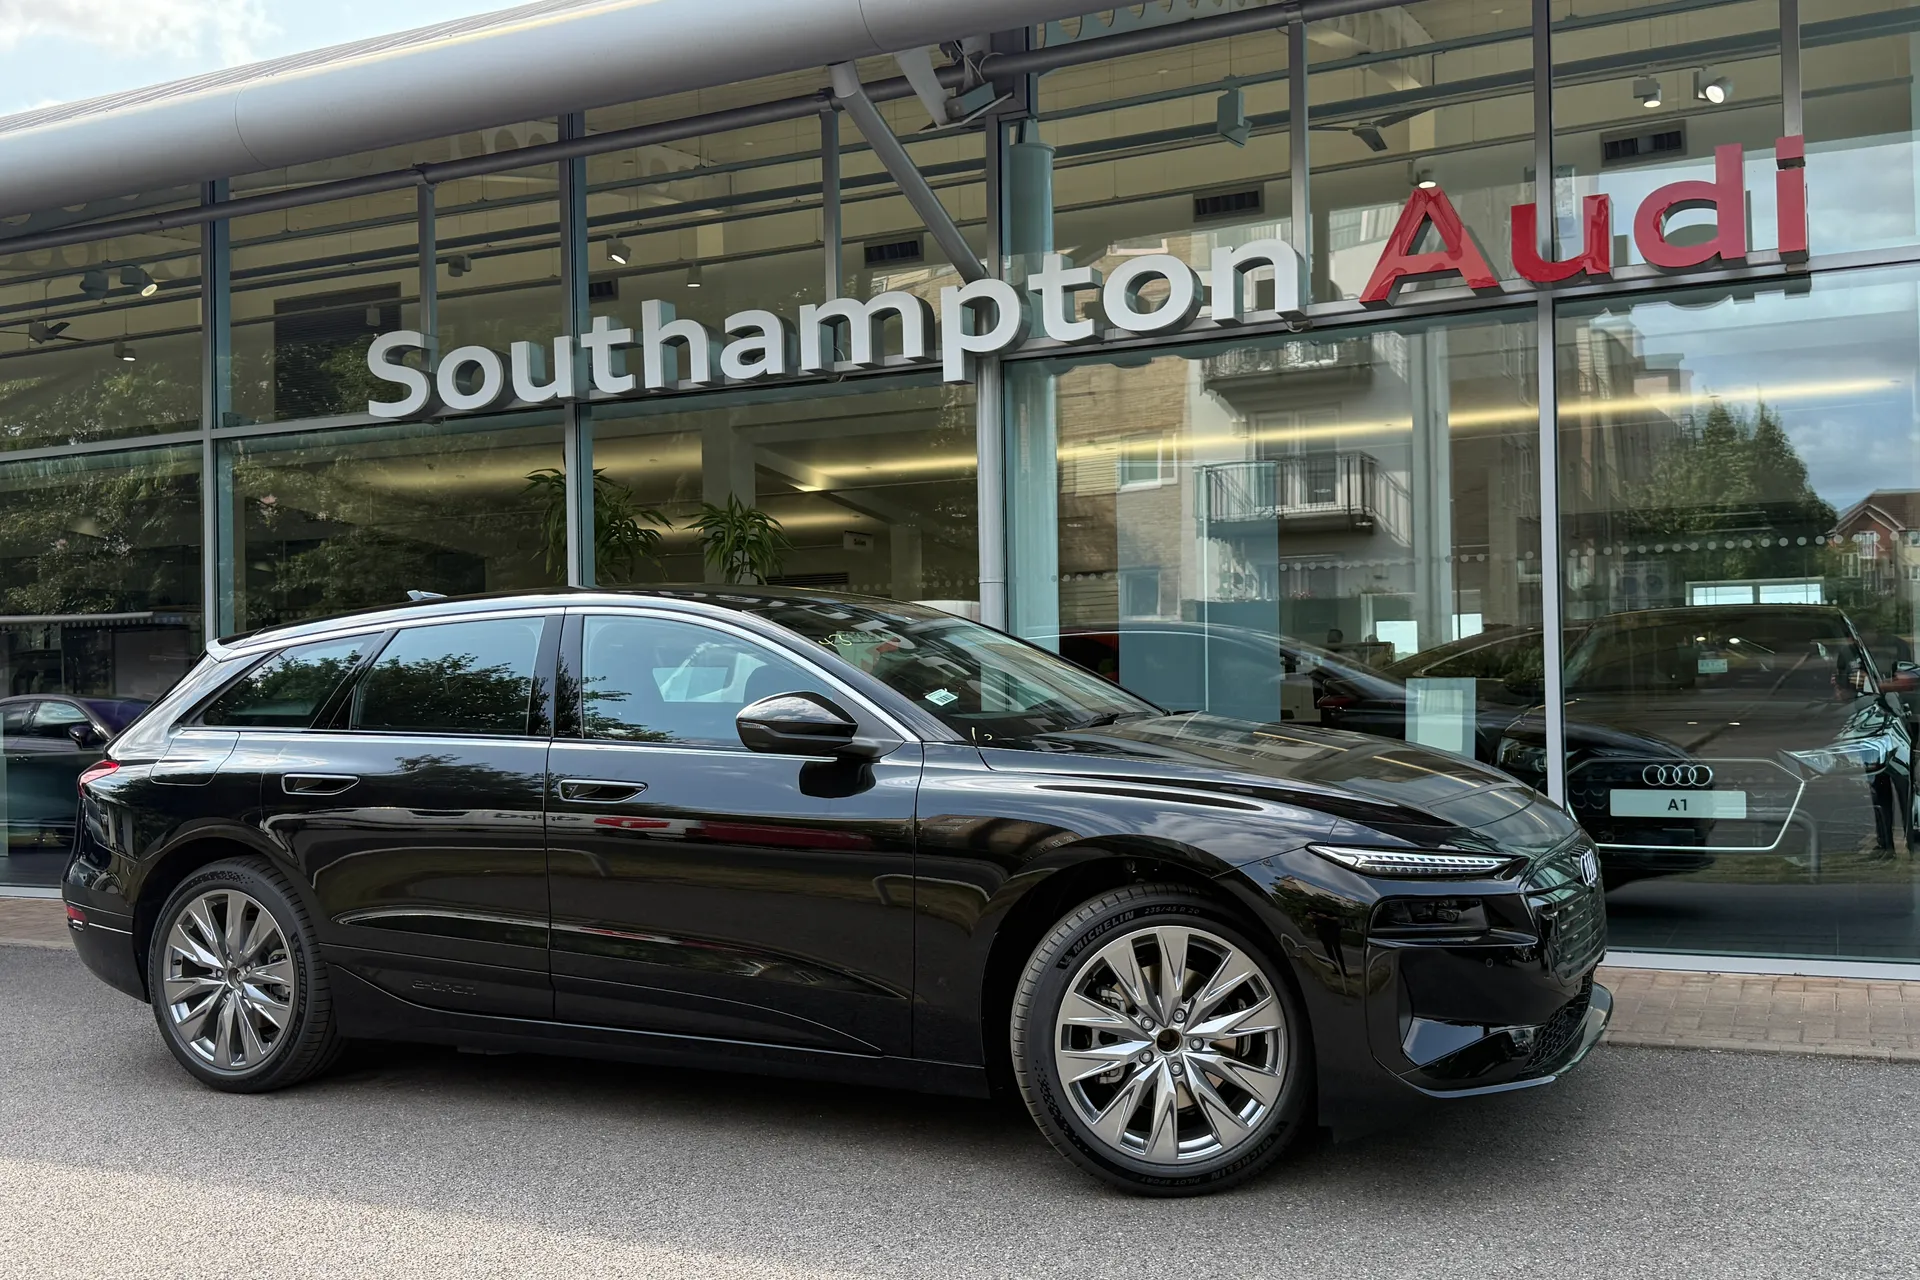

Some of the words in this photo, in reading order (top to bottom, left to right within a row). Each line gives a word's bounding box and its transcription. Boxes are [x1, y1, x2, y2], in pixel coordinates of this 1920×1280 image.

[368, 239, 1307, 418] Southampton
[1359, 135, 1808, 305] Audi
[1667, 798, 1688, 812] A1
[1071, 910, 1135, 955] MICHELIN
